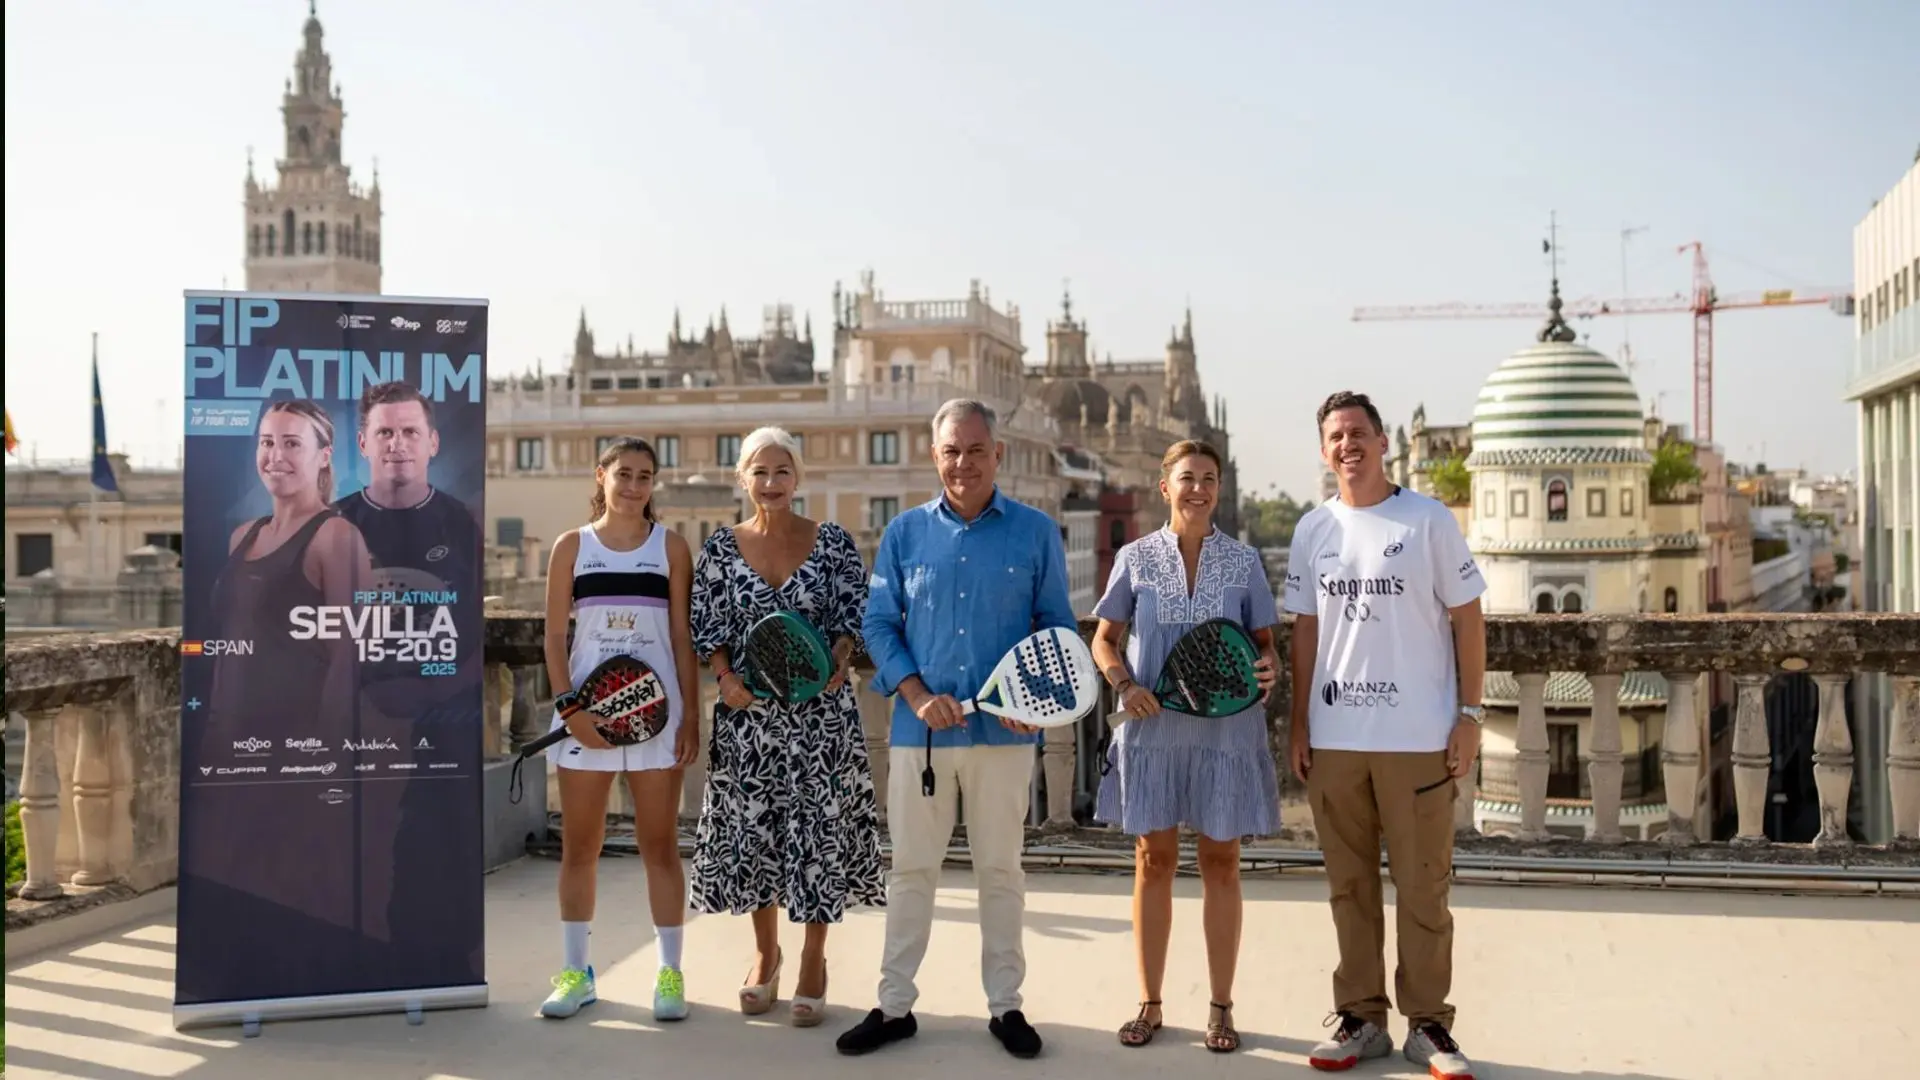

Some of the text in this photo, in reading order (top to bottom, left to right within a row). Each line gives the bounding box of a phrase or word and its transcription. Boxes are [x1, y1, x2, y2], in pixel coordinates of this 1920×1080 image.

[185, 297, 280, 346] FIP
[185, 346, 481, 403] PLATINUM
[1319, 572, 1405, 601] Seagram's
[354, 591, 457, 604] FIP PLATINUM
[288, 605, 459, 640] SEVILLA
[203, 640, 254, 656] SPAIN
[355, 638, 457, 662] 15-20.9
[421, 663, 457, 675] 2025
[1343, 681, 1399, 694] MANZA
[285, 738, 322, 749] Sevilla
